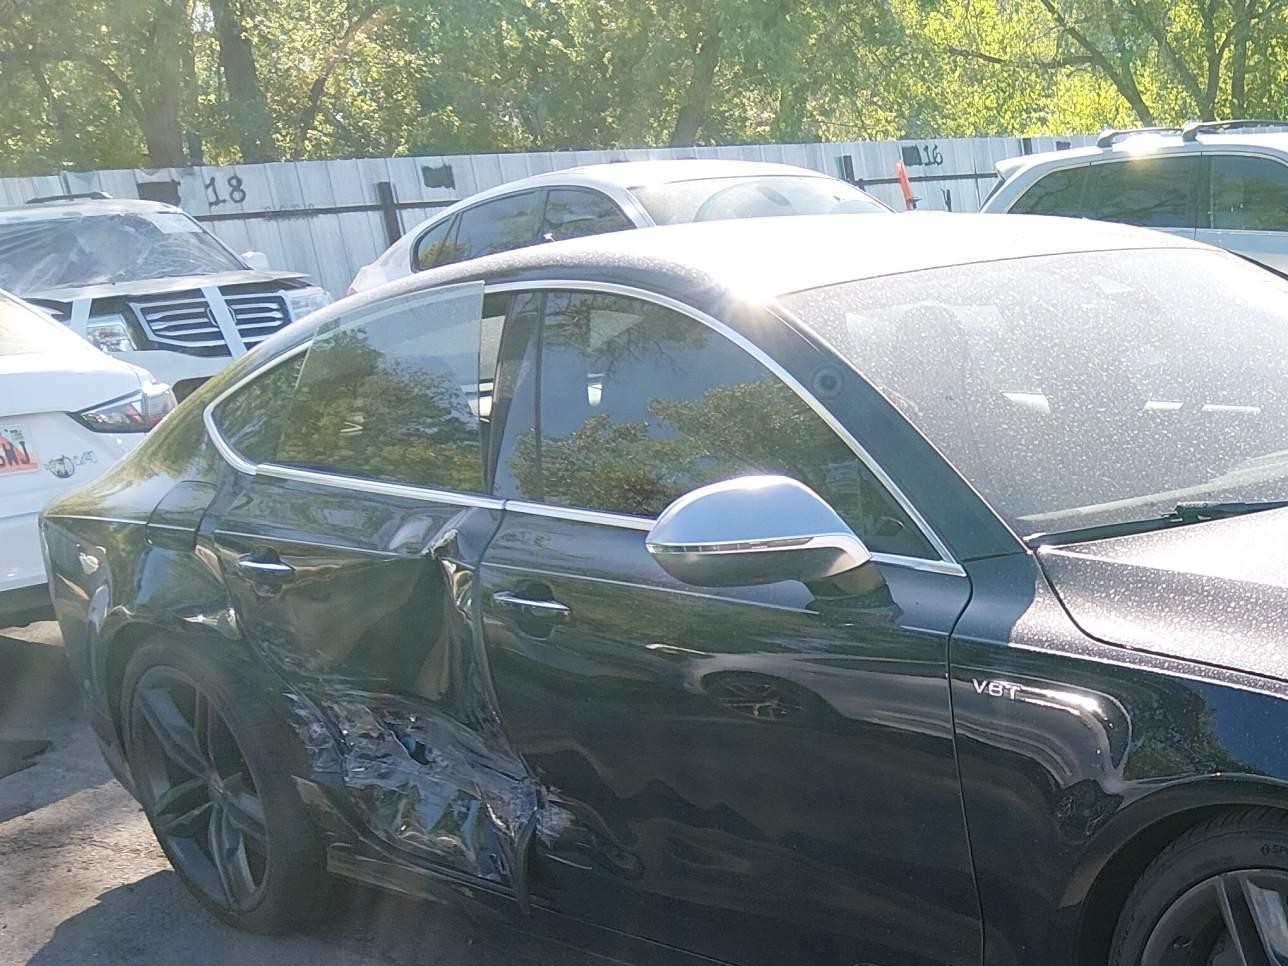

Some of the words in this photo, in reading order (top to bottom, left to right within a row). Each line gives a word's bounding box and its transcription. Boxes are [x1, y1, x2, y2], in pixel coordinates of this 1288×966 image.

[923, 144, 944, 166] 16
[205, 175, 247, 207] 18
[972, 678, 1021, 701] V8T
